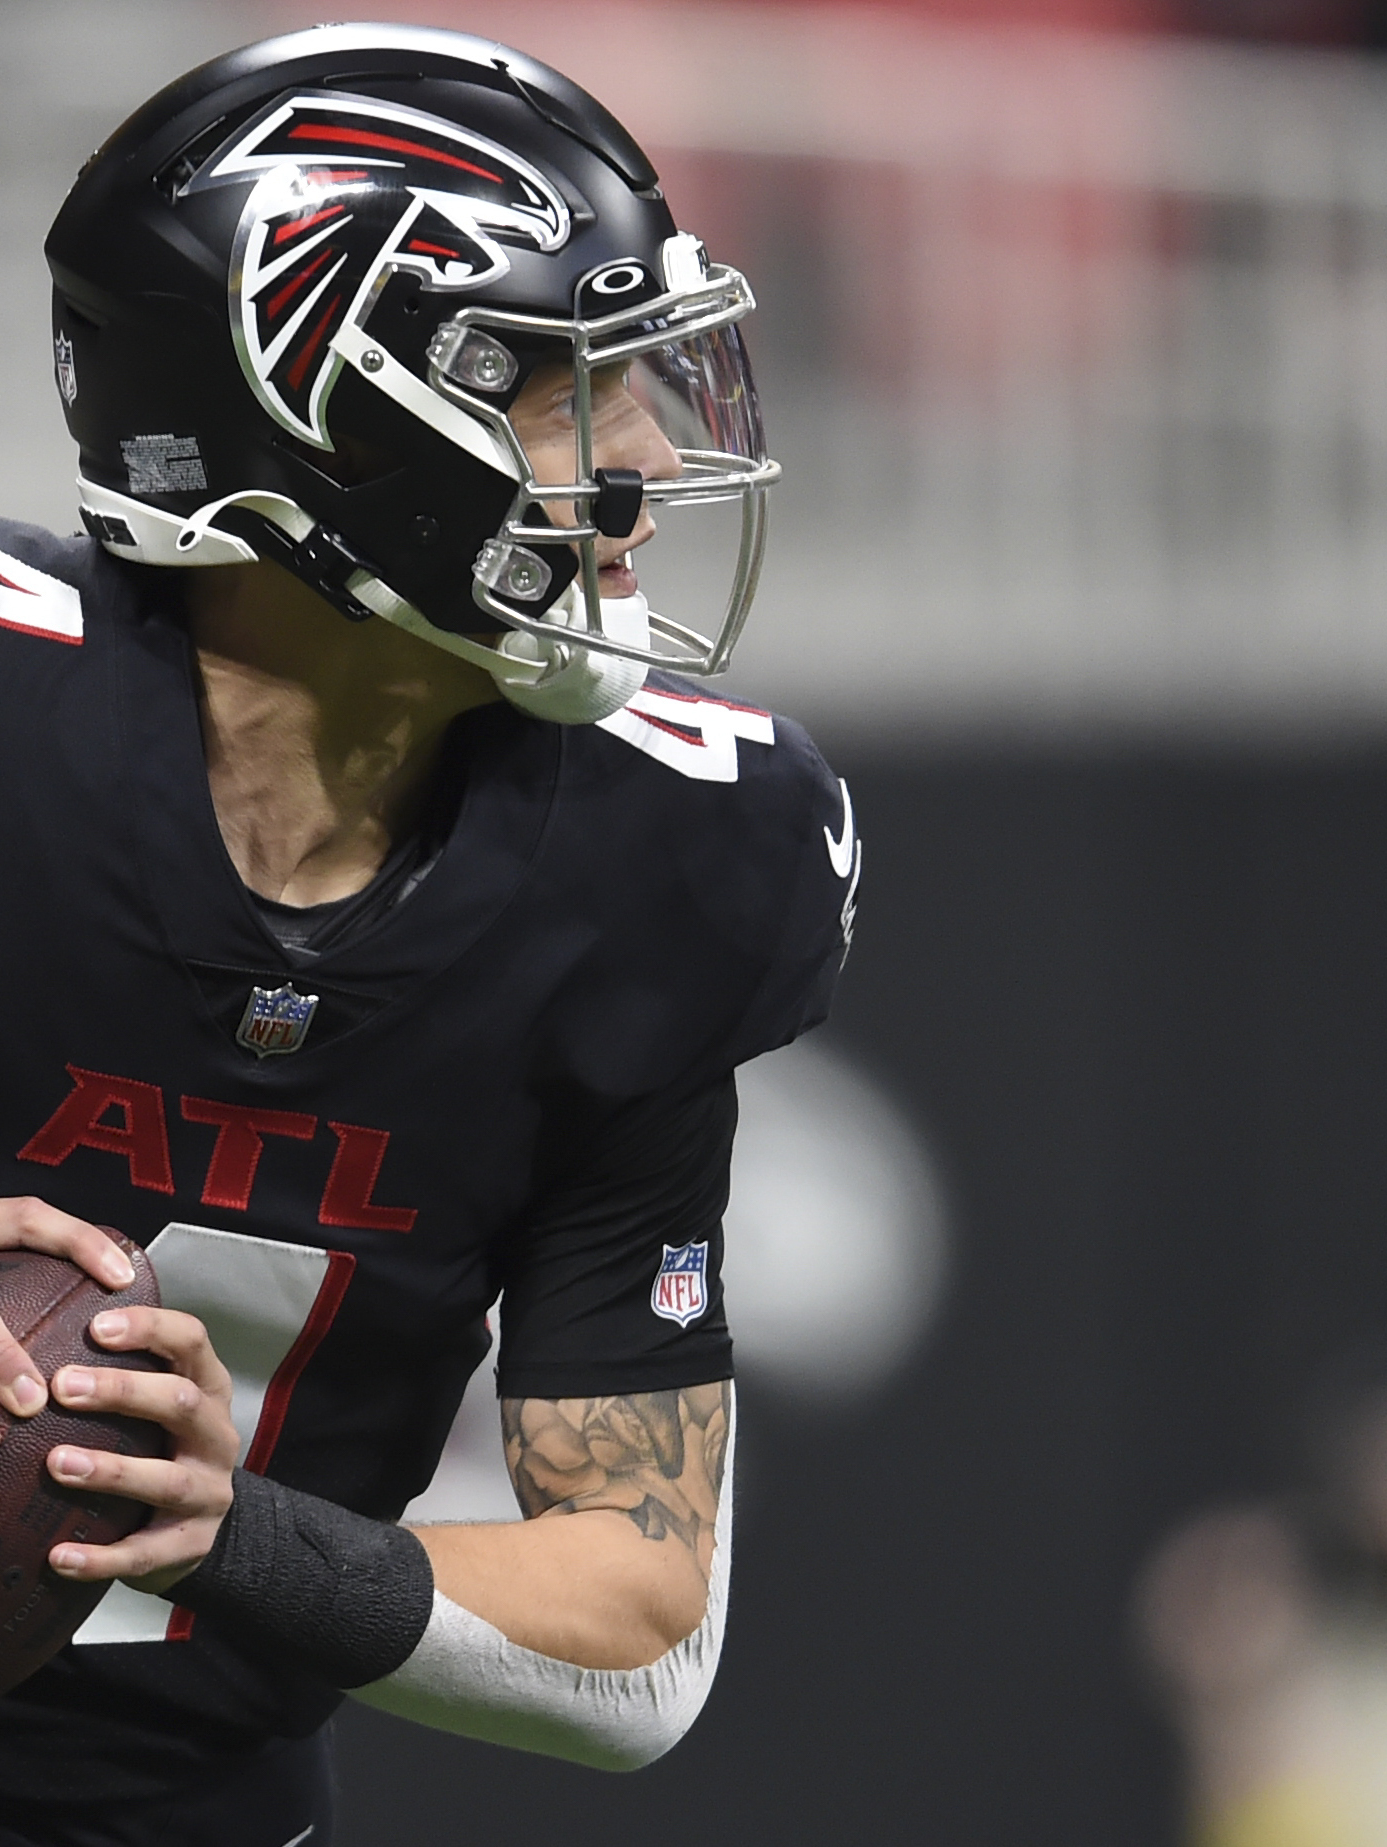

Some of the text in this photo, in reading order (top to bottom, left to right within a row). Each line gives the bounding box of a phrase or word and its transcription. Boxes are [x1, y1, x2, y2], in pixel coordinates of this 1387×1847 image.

[595, 685, 776, 783] 4
[247, 1018, 296, 1047] NFL
[17, 1063, 419, 1234] ATL
[657, 1274, 700, 1312] NFL
